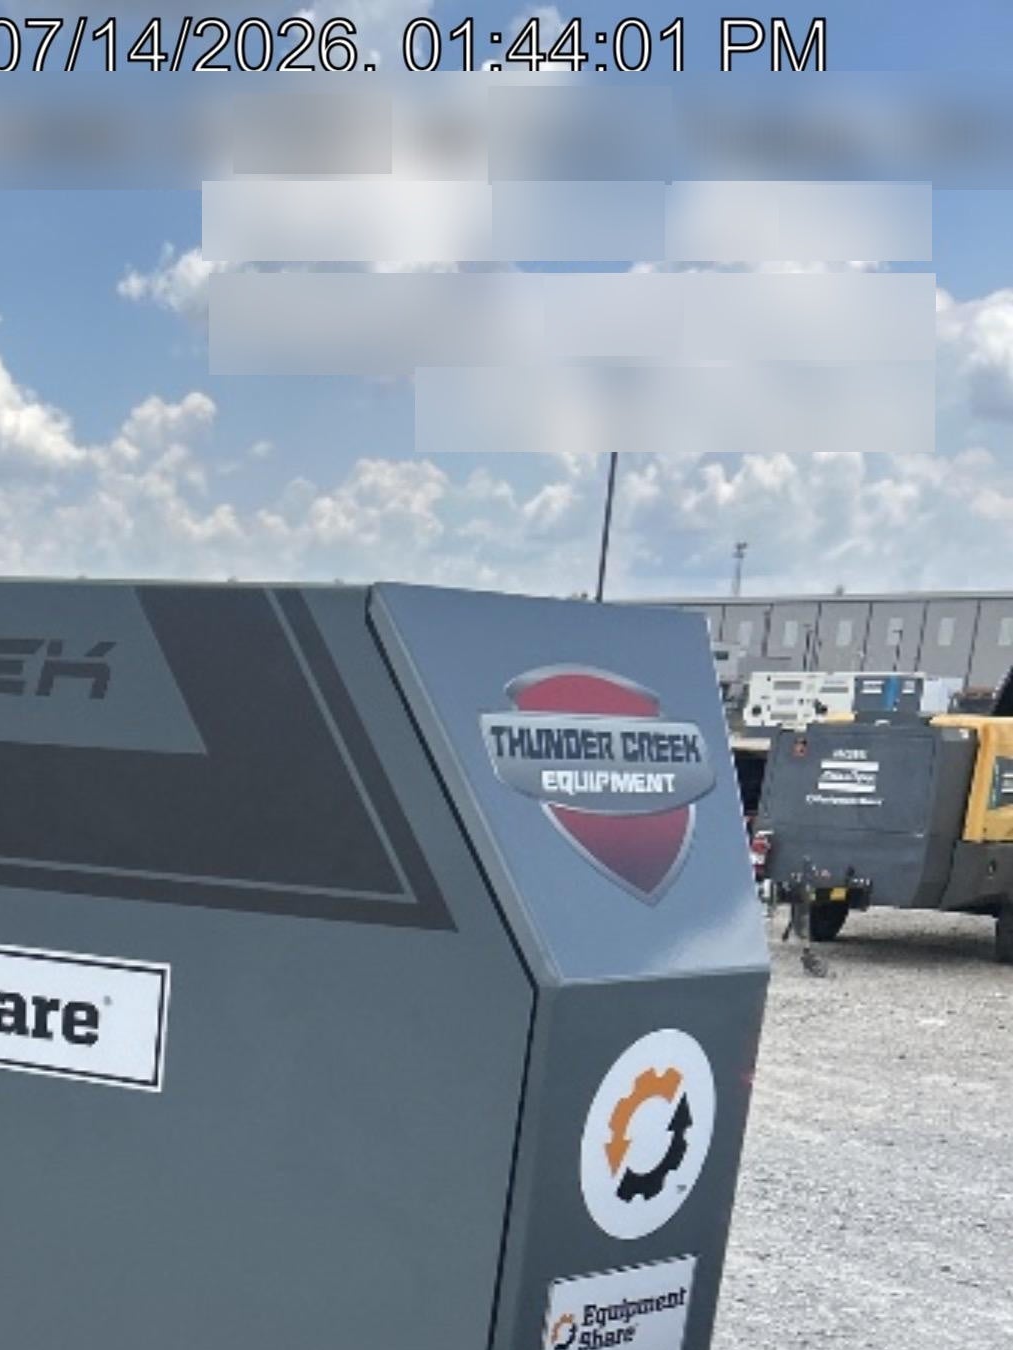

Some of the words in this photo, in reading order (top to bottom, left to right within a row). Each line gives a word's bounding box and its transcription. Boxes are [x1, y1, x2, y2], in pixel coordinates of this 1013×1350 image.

[490, 725, 615, 761] THUNDER
[620, 730, 702, 763] CREEK
[541, 769, 676, 796] EQUIPMENT
[581, 1286, 688, 1328] Equipment
